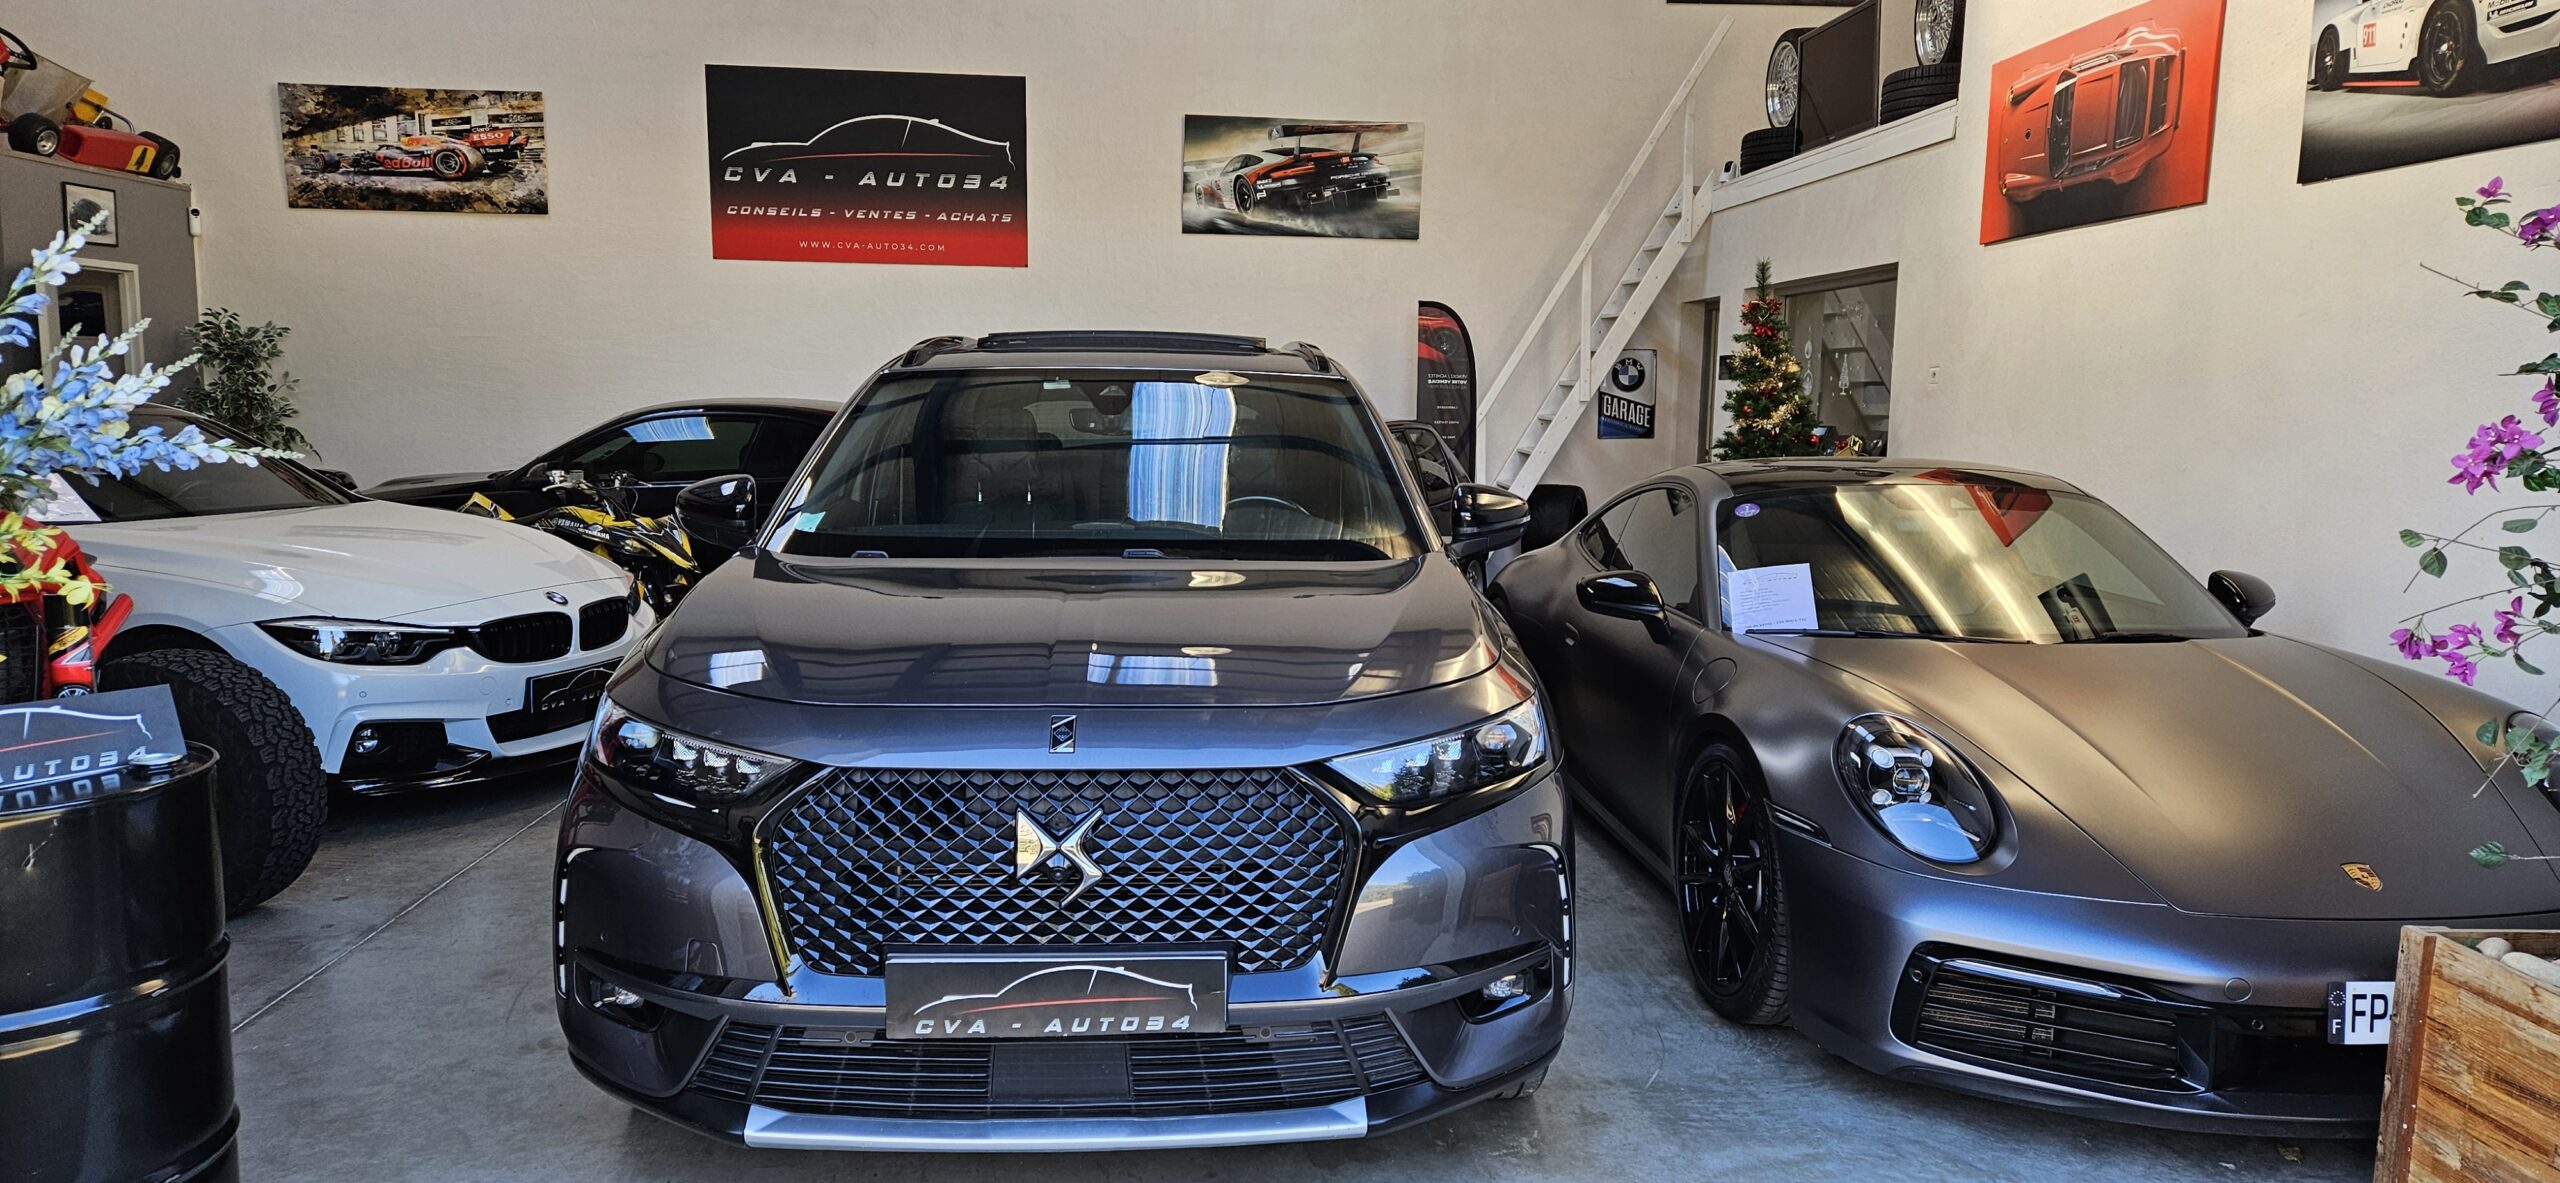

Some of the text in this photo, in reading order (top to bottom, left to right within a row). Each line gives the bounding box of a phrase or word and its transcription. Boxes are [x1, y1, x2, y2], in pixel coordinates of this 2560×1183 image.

[2363, 24, 2376, 47] 911
[472, 132, 504, 141] ESSO
[724, 166, 798, 184] CVA
[858, 171, 1008, 190] AUTO34
[727, 205, 822, 217] CONSEILS
[844, 209, 917, 220] VENTES
[936, 212, 1013, 223] ACHATS
[799, 240, 945, 252] WWW.CVA-AUTO34.COM
[1615, 359, 1644, 371] BMW
[1603, 395, 1651, 428] GARAGE
[541, 701, 566, 711] CVA
[0, 745, 147, 783] UTO34
[915, 1018, 986, 1035] CVA
[1044, 1015, 1190, 1033] AUTO34
[2332, 1018, 2342, 1035] F
